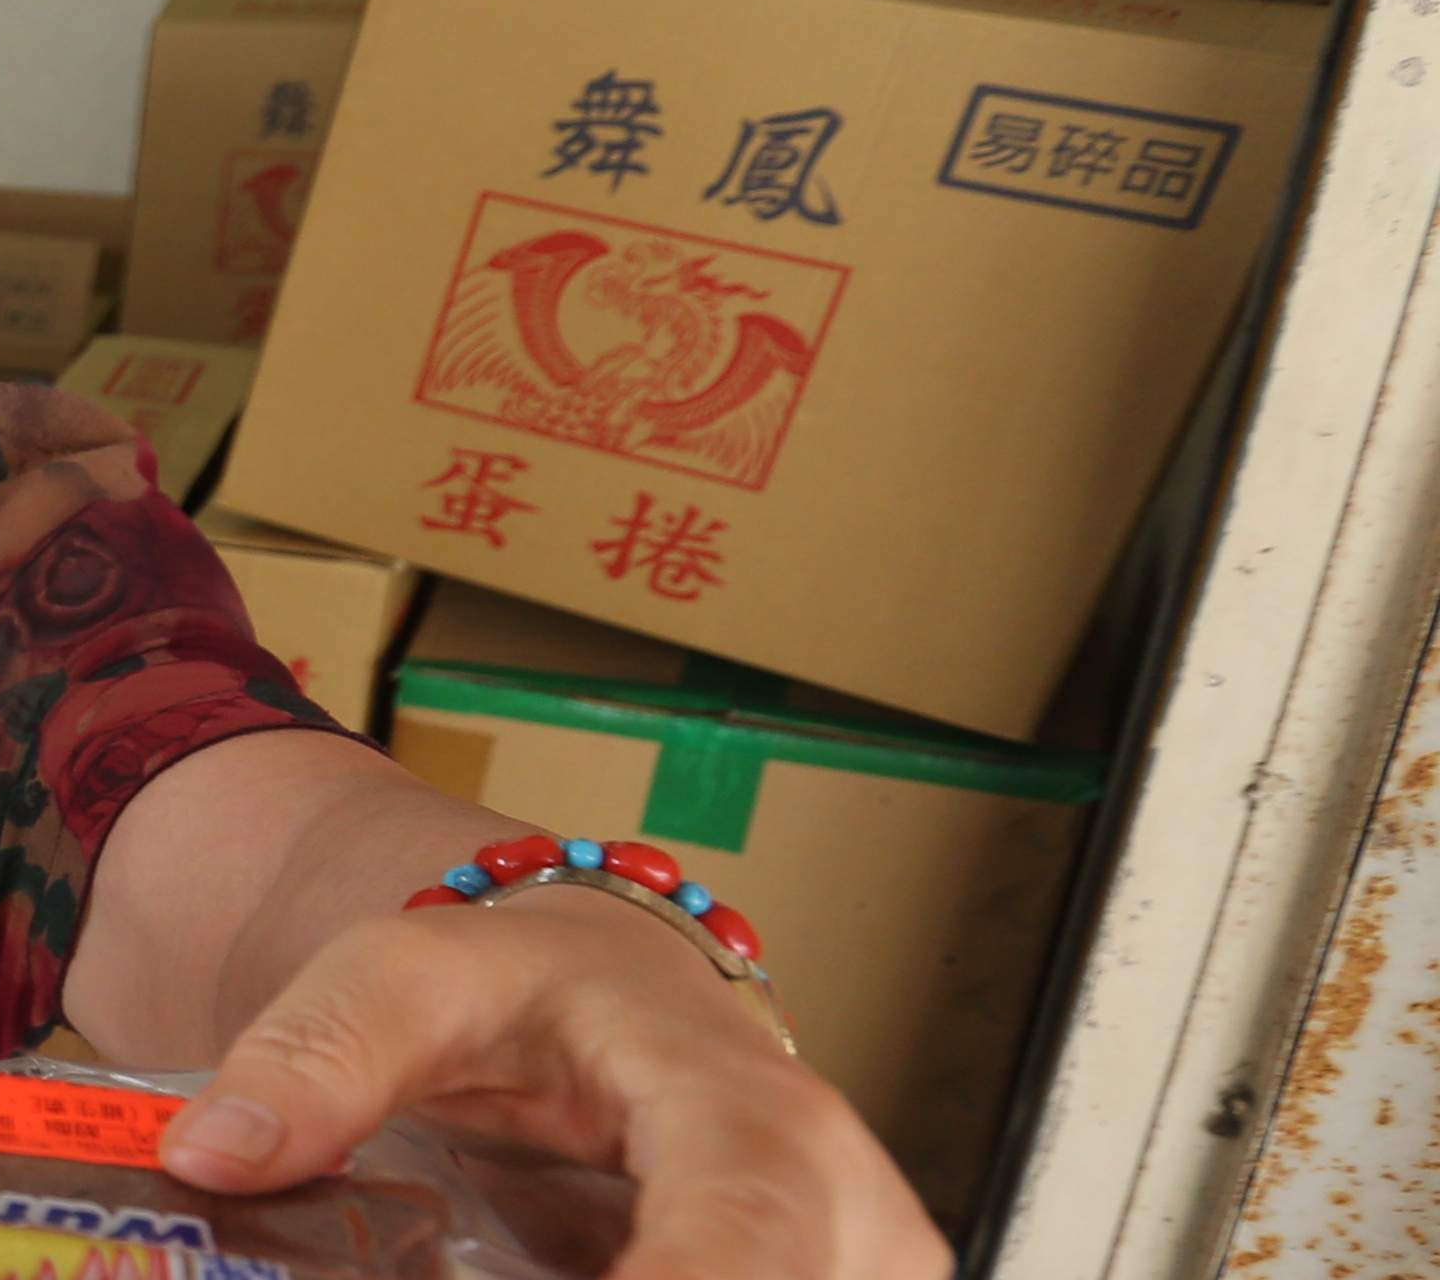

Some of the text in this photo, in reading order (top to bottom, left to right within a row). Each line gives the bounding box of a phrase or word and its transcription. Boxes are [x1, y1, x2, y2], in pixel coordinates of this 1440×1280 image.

[539, 69, 845, 228] 舞鳳
[964, 111, 1210, 204] 易碎品
[419, 445, 727, 605] 蛋捲
